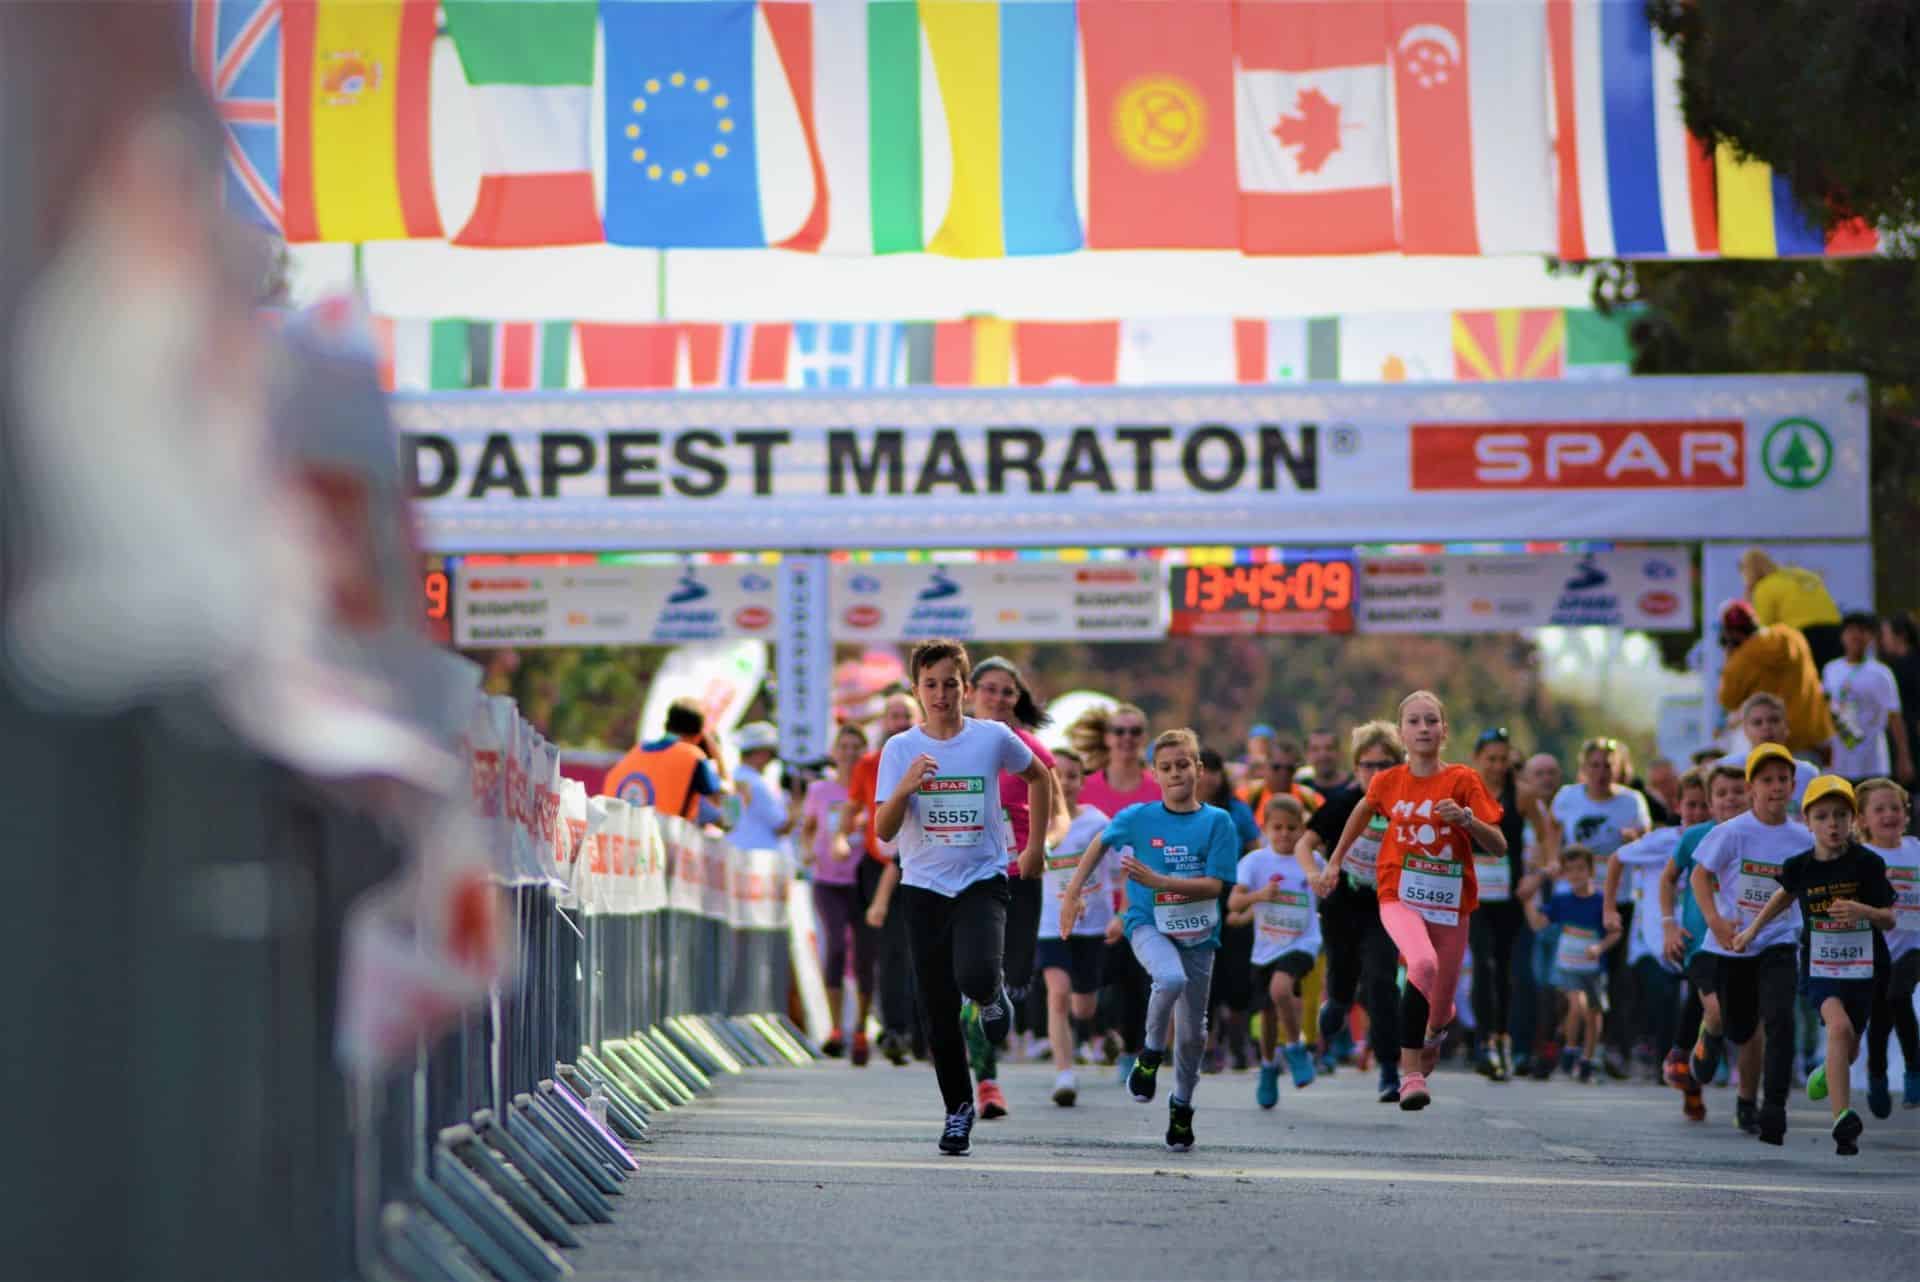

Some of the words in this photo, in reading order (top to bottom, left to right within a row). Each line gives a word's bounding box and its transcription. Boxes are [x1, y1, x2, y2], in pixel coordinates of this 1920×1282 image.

[827, 425, 1318, 494] MARATON
[1474, 431, 1738, 482] SPAR
[1185, 563, 1352, 613] 13:45:09
[929, 781, 968, 791] SPAR
[928, 810, 978, 823] 55557
[1407, 887, 1454, 904] 55492
[1166, 915, 1209, 930] 55196
[1820, 946, 1863, 959] 55421
